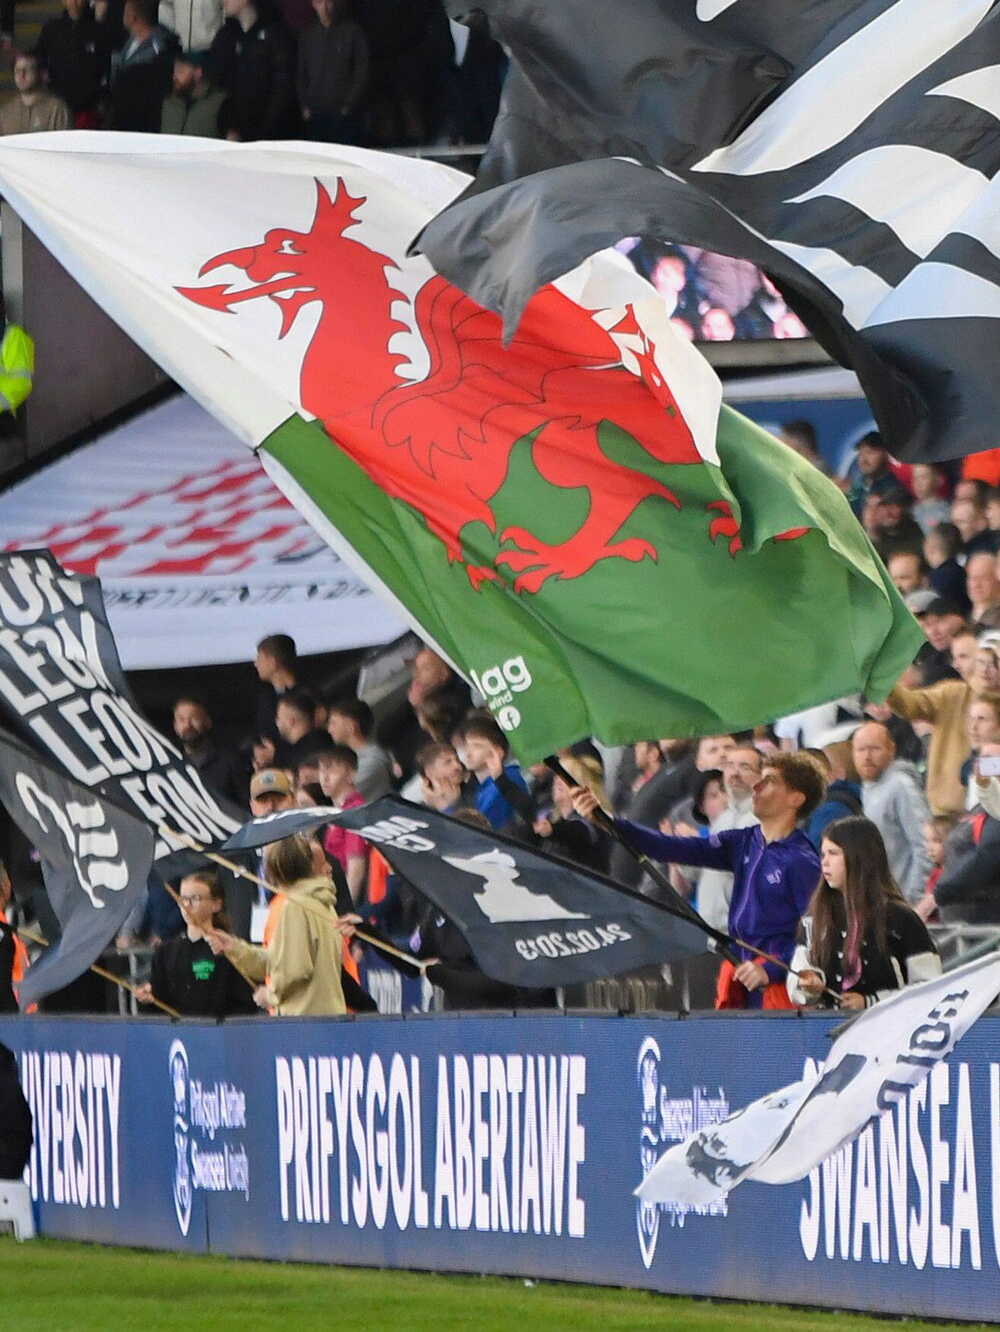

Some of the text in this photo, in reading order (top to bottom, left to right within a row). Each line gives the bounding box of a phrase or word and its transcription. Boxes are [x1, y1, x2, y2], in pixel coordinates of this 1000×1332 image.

[121, 764, 242, 860] EON
[275, 1052, 586, 1238] PRIFYSGOL ABERTAWE
